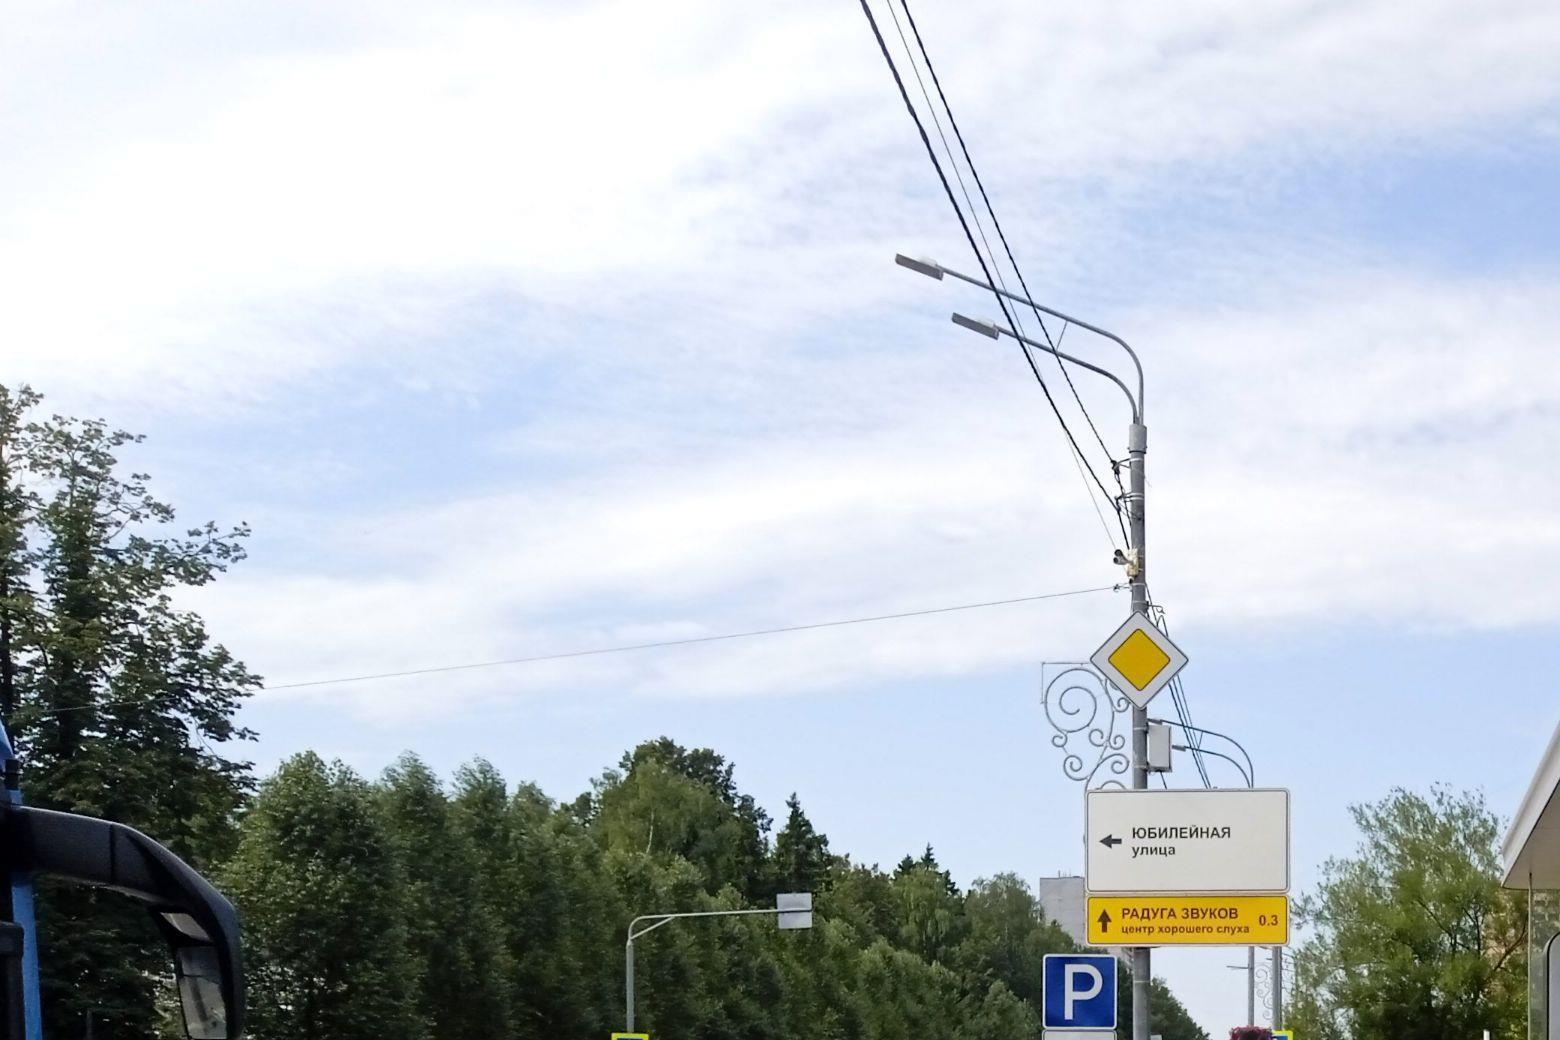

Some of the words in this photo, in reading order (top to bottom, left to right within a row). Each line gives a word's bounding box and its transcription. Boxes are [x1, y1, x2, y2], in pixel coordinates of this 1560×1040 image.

[1132, 825, 1231, 839] ЮБИЛЕЙНАЯ
[1131, 845, 1176, 858] улица
[1122, 907, 1177, 920] РАДУГА
[1181, 907, 1239, 920] ЗВУКОВ
[1259, 914, 1279, 927] 0.3
[1121, 926, 1155, 935] центр
[1158, 925, 1214, 936] хорошего
[1216, 925, 1250, 935] слуха
[1064, 963, 1103, 1020] P
